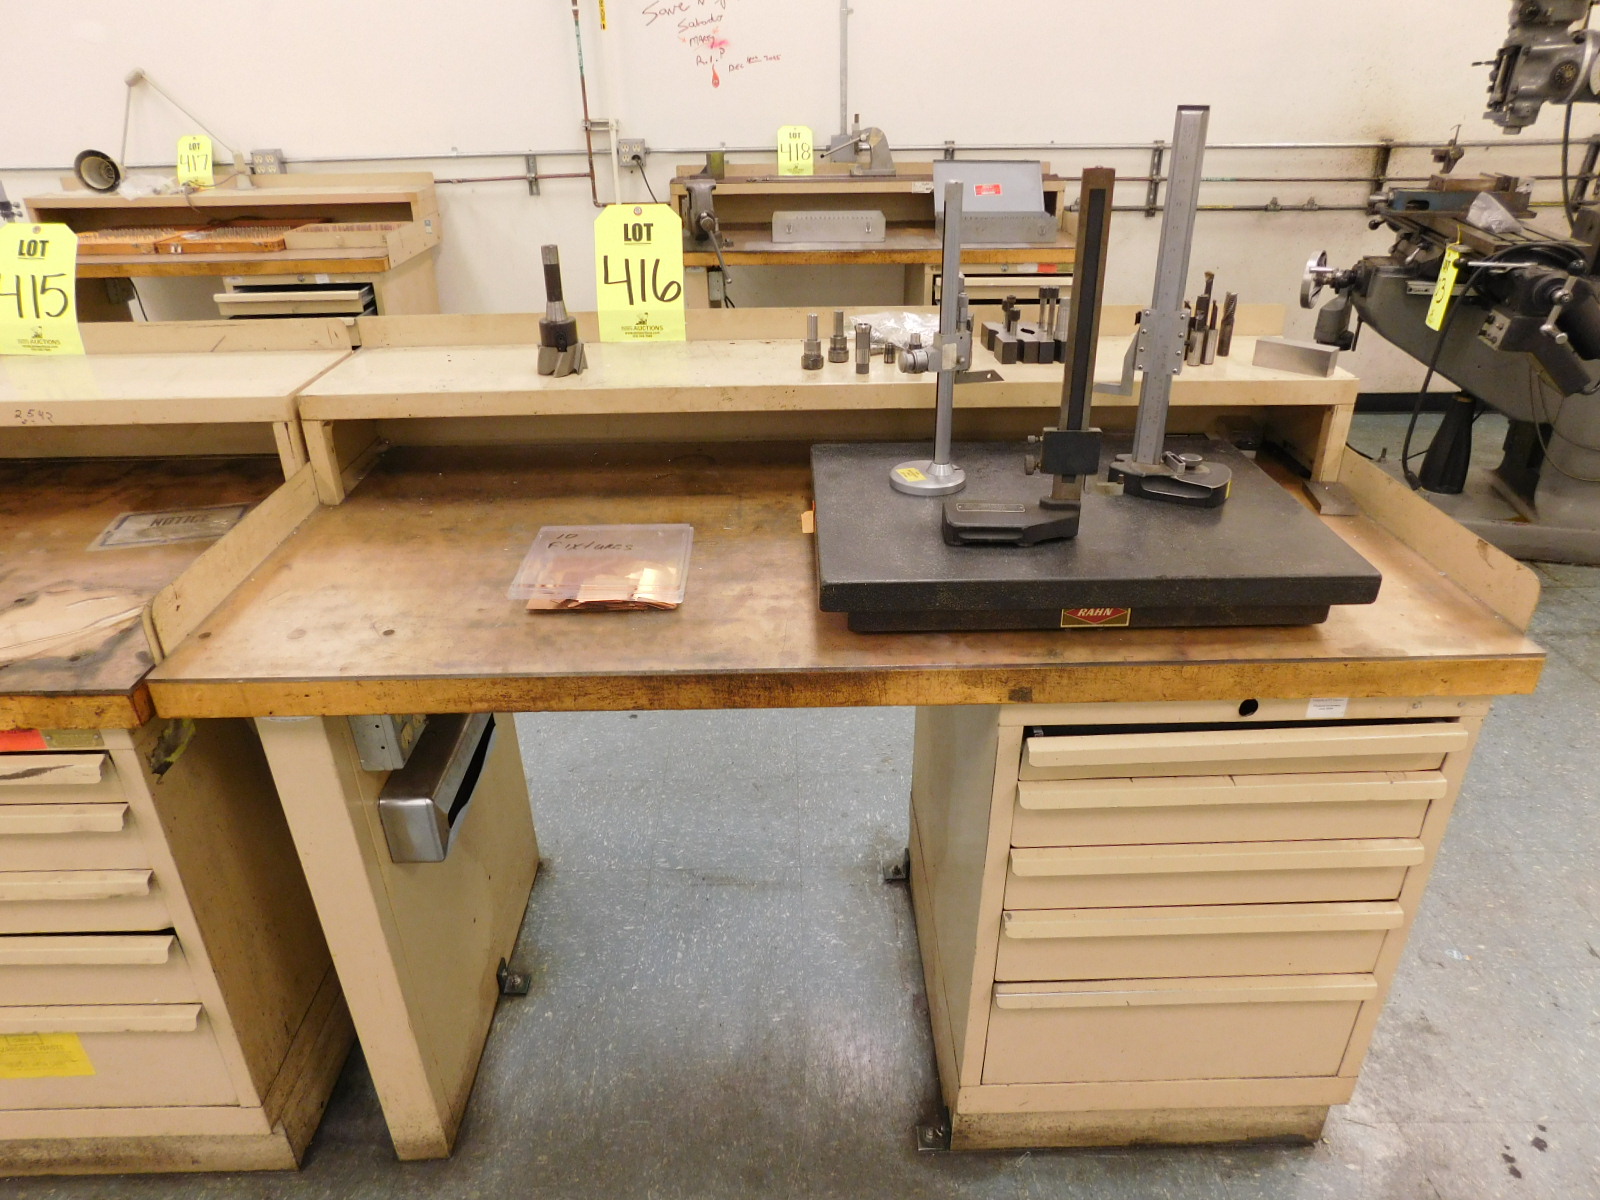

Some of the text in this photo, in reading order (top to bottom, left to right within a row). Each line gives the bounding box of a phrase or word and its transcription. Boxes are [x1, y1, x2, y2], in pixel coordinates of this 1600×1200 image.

[188, 142, 200, 151] LOT
[780, 143, 811, 162] 418
[180, 153, 208, 172] 417
[623, 223, 654, 242] LOT
[18, 239, 49, 257] LOT
[603, 255, 682, 306] 416
[1077, 607, 1113, 617] RAHN
